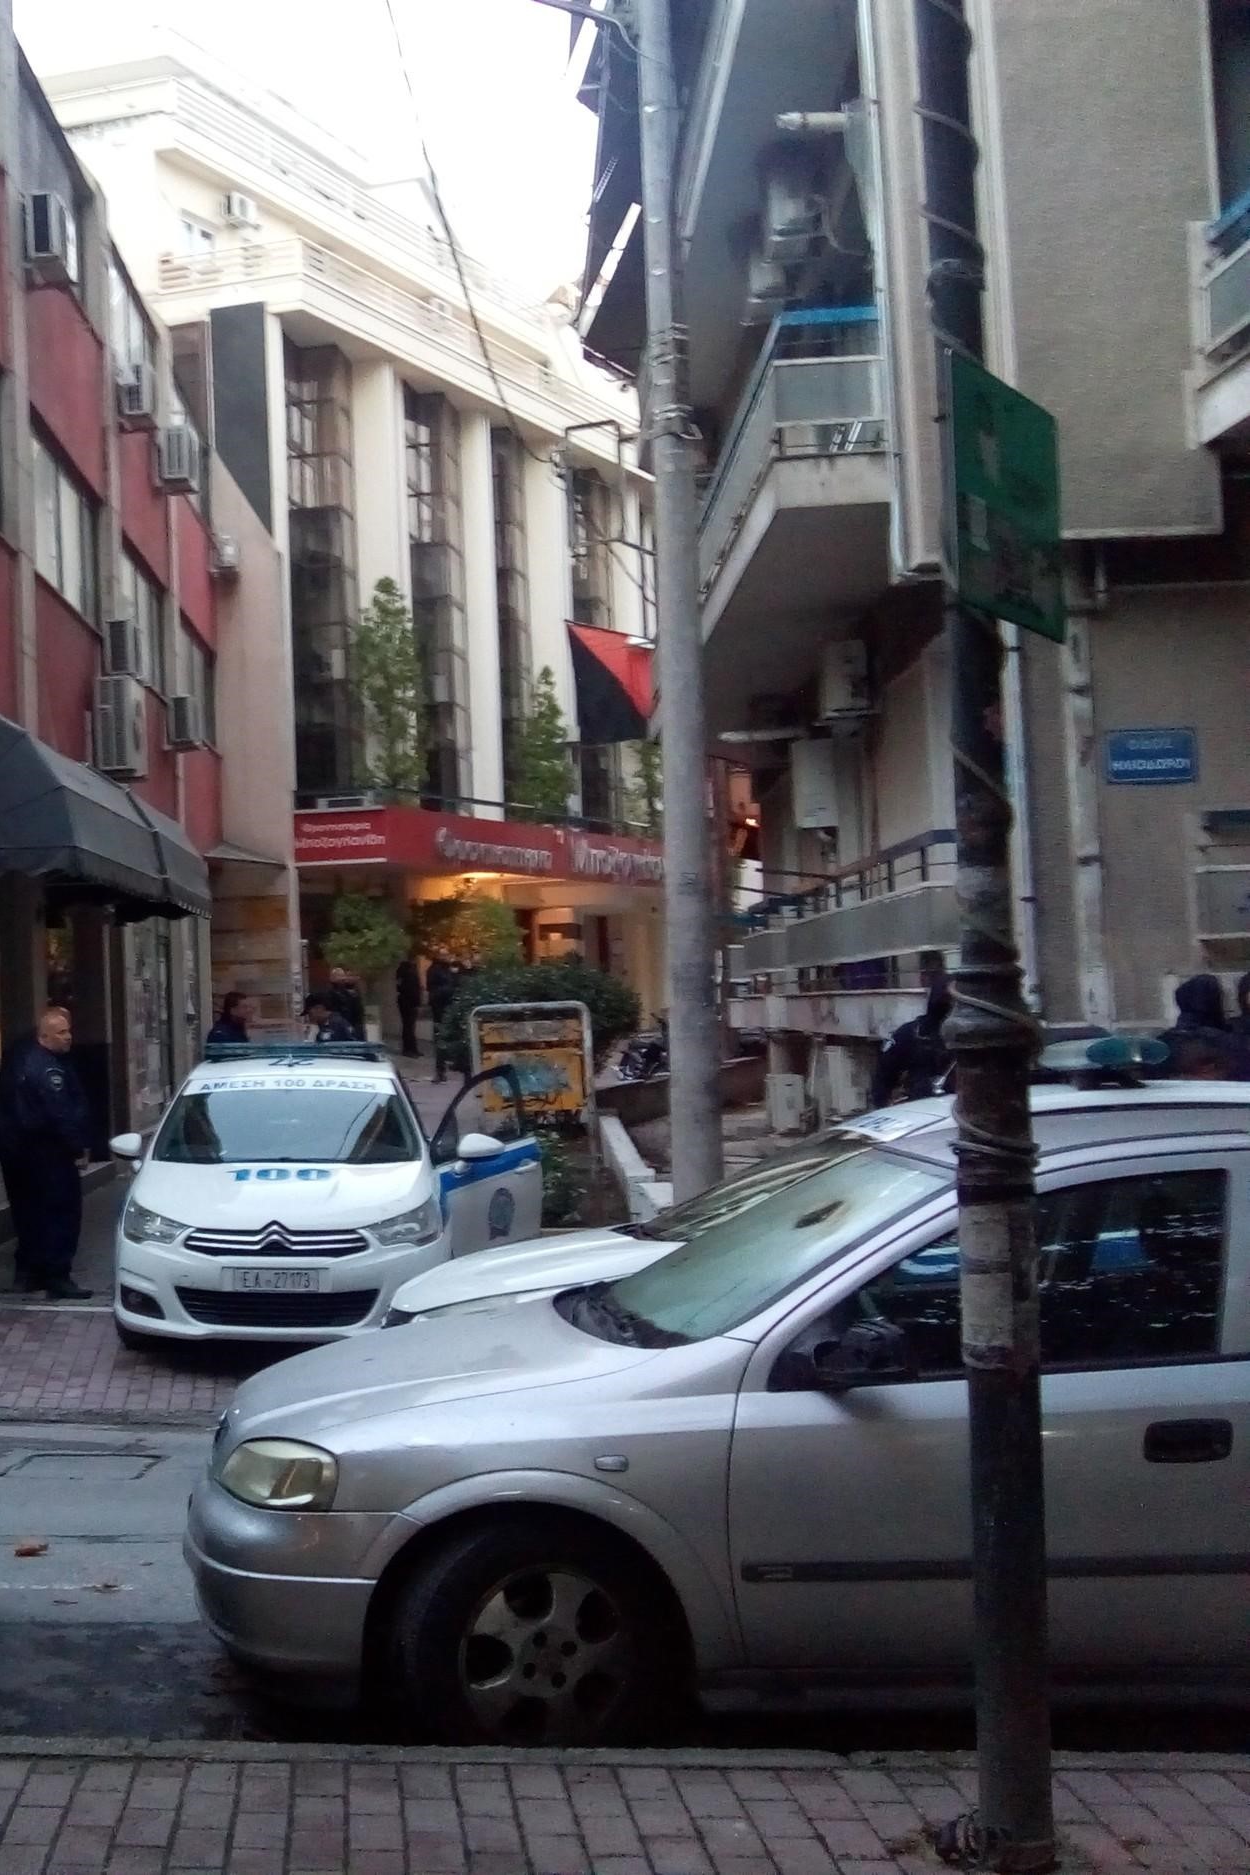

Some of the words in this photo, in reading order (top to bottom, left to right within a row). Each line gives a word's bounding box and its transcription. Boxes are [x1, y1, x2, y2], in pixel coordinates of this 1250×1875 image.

[201, 1079, 266, 1091] ΑΜΕΣΗ
[274, 1079, 306, 1088] 100
[312, 1080, 377, 1091] ΔΡΑΣΗ
[226, 1168, 331, 1182] 100
